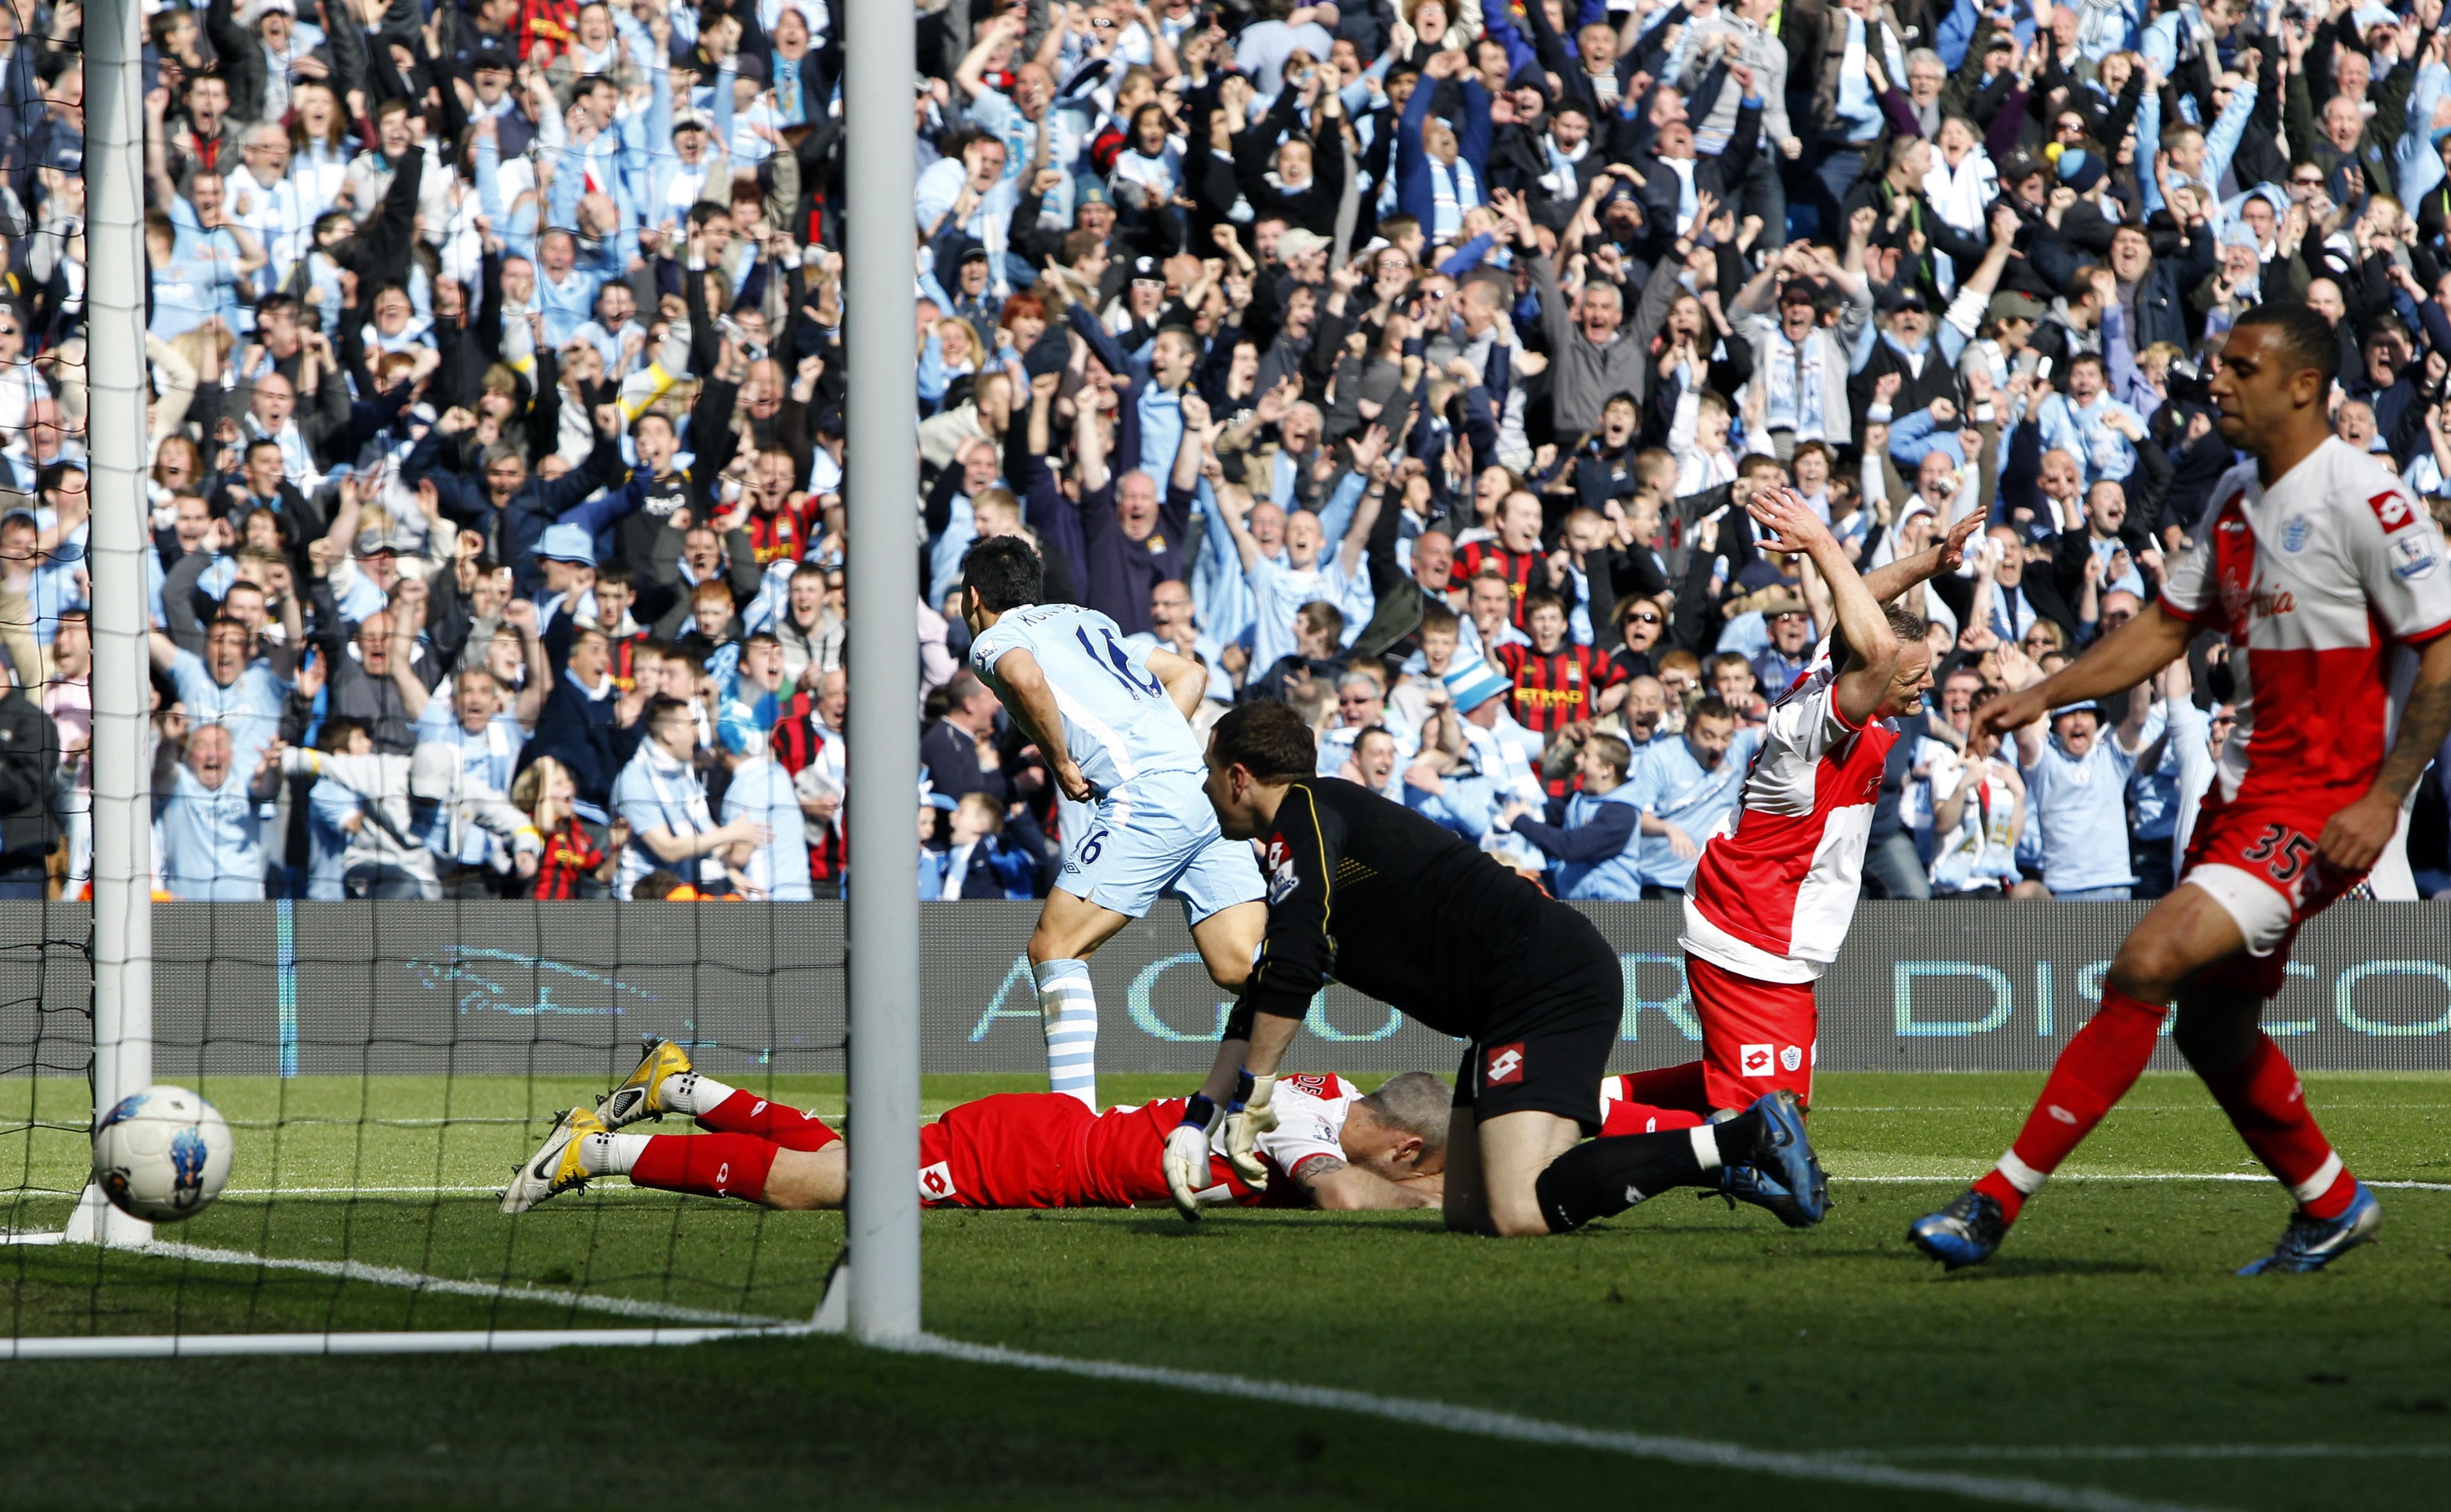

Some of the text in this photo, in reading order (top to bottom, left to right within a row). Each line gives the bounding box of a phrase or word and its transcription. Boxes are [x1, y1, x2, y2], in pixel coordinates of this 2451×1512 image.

[1017, 611, 1060, 627] KUN
[1075, 623, 1162, 701] 16
[1515, 687, 1584, 704] ETIHAD
[2241, 824, 2318, 882] 35
